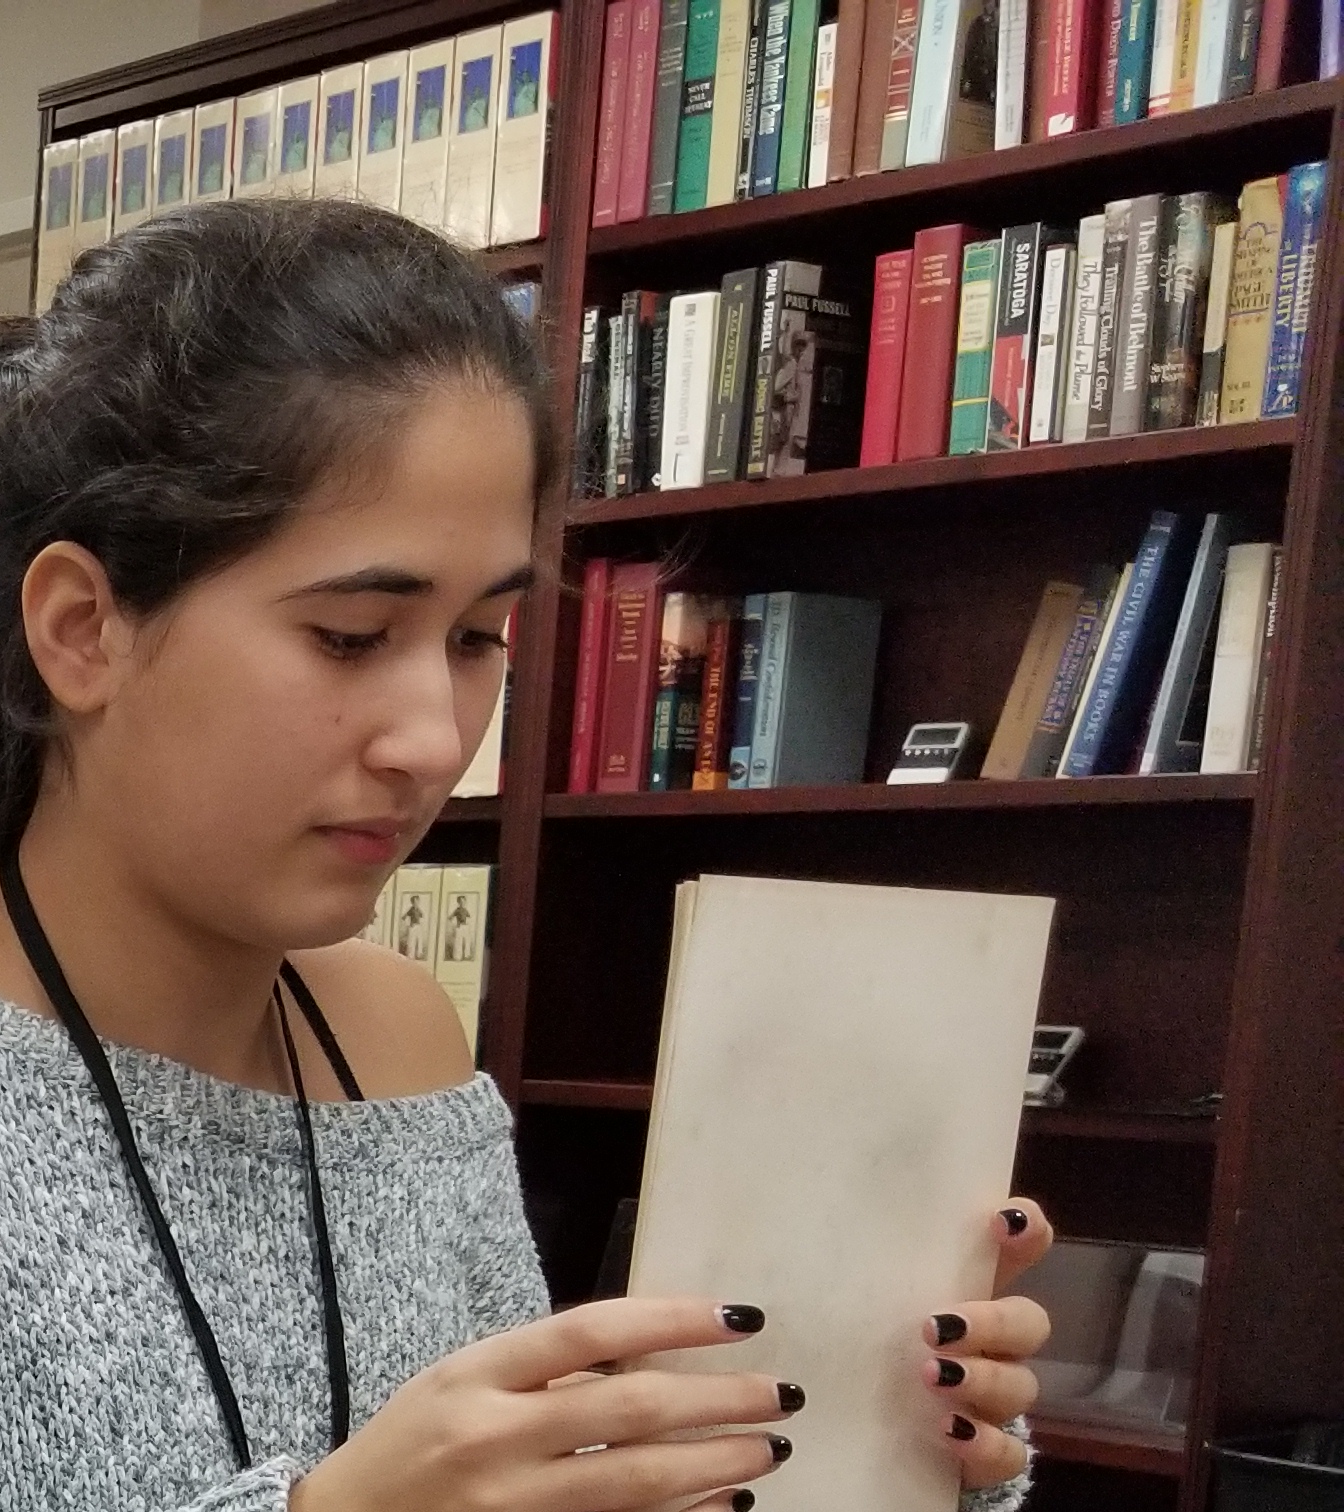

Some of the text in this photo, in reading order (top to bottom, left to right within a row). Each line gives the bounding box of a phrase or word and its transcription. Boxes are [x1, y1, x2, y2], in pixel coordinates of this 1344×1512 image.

[747, 37, 758, 84] CHARLES
[759, 2, 789, 134] When the Yankees Came
[760, 268, 778, 352] PAUL FUSSELL
[785, 295, 851, 316] PAUL FUSSELL
[1010, 243, 1030, 318] SARATOGA
[1077, 262, 1097, 292] They
[1122, 216, 1157, 391] The Battle of Belmont
[1275, 254, 1298, 326] LIBERTY
[1076, 294, 1095, 347] Followed
[1090, 263, 1118, 410] Trailing Clouds of Glory
[1072, 363, 1088, 401] Plume
[1083, 547, 1159, 742] THE CIVIL WAR IN BOOKS
